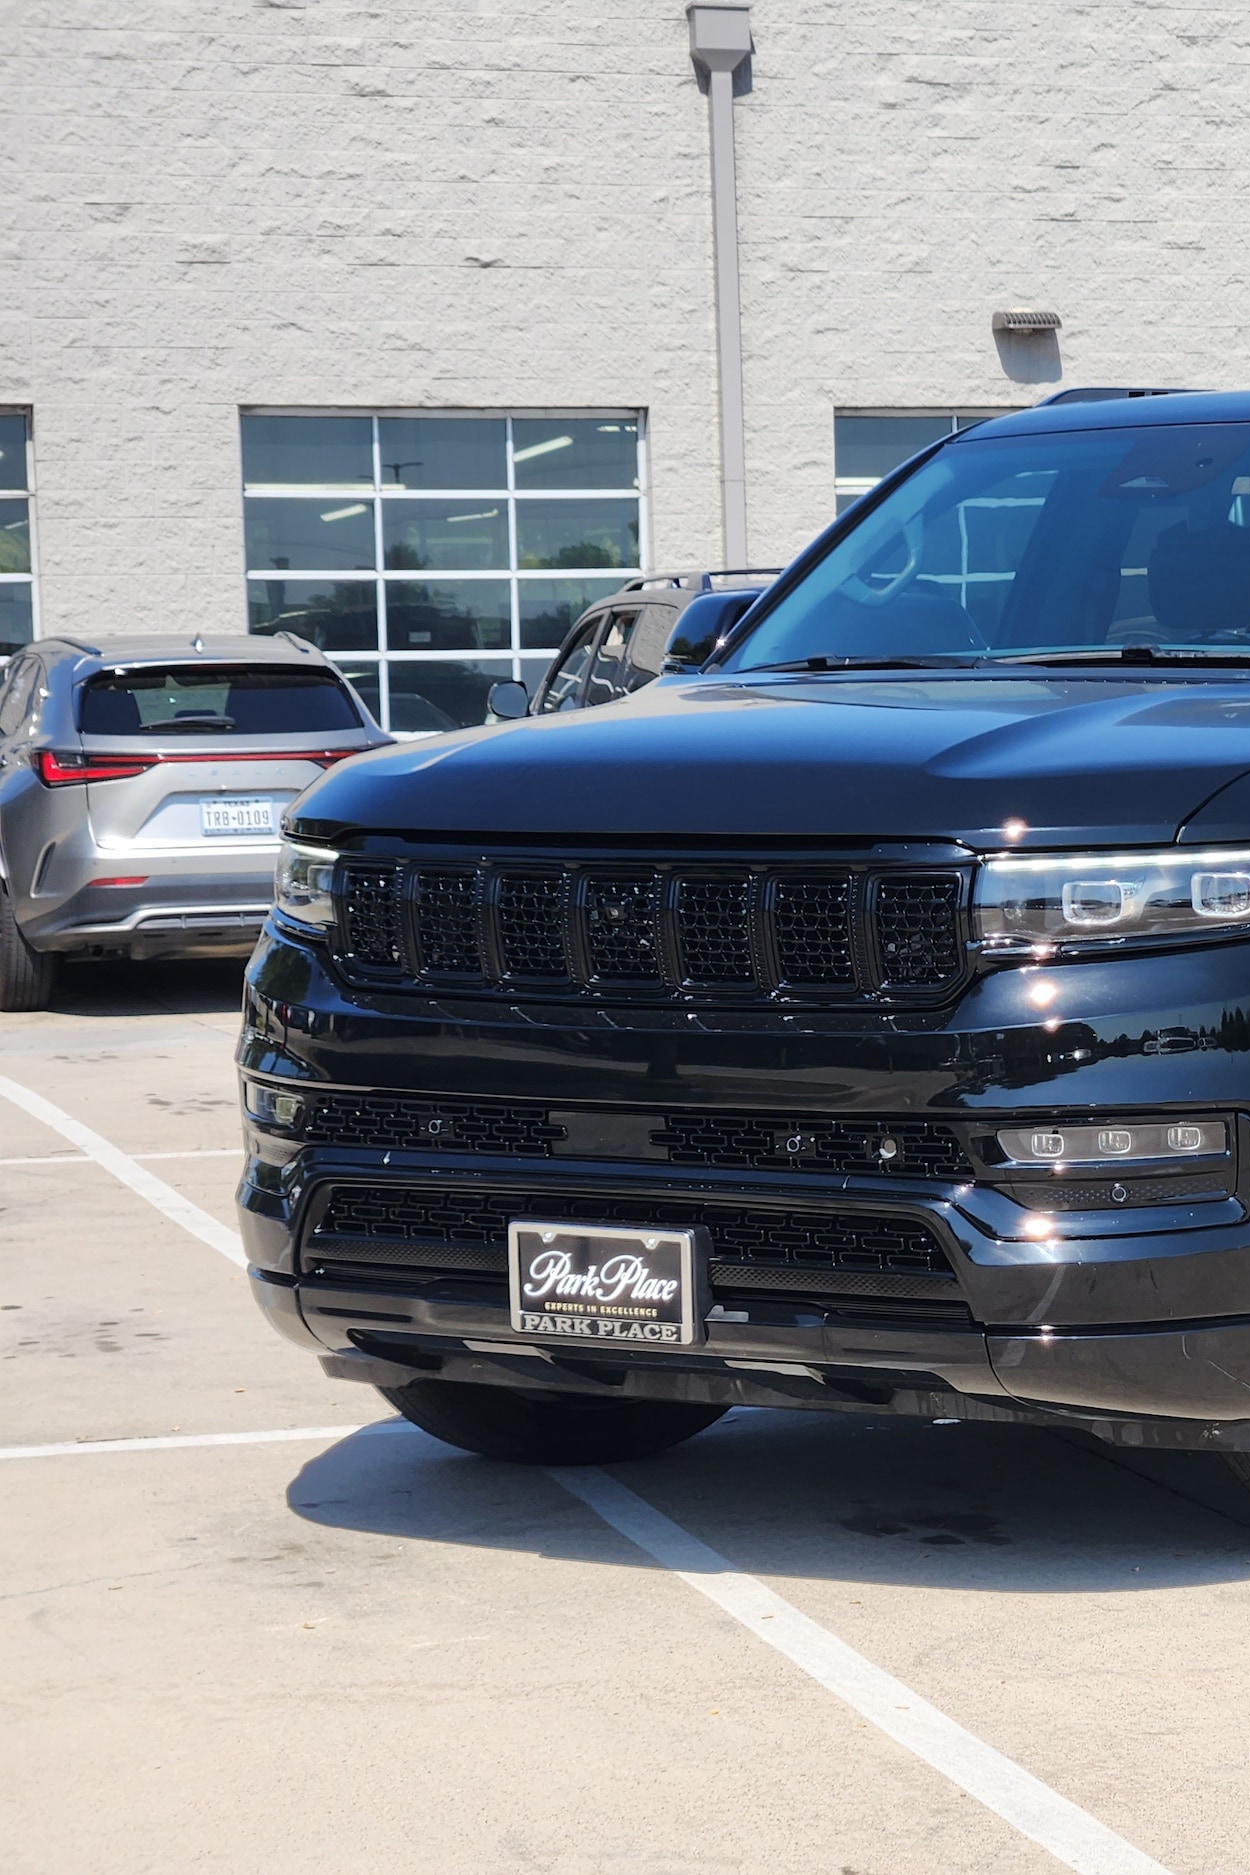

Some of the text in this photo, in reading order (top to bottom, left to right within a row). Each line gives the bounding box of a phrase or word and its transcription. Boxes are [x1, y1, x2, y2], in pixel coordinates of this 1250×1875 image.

[523, 1250, 678, 1302] Park Place
[544, 1301, 658, 1318] EXPERTS IN EXCELLENCE
[523, 1314, 679, 1342] PARK PLACE
